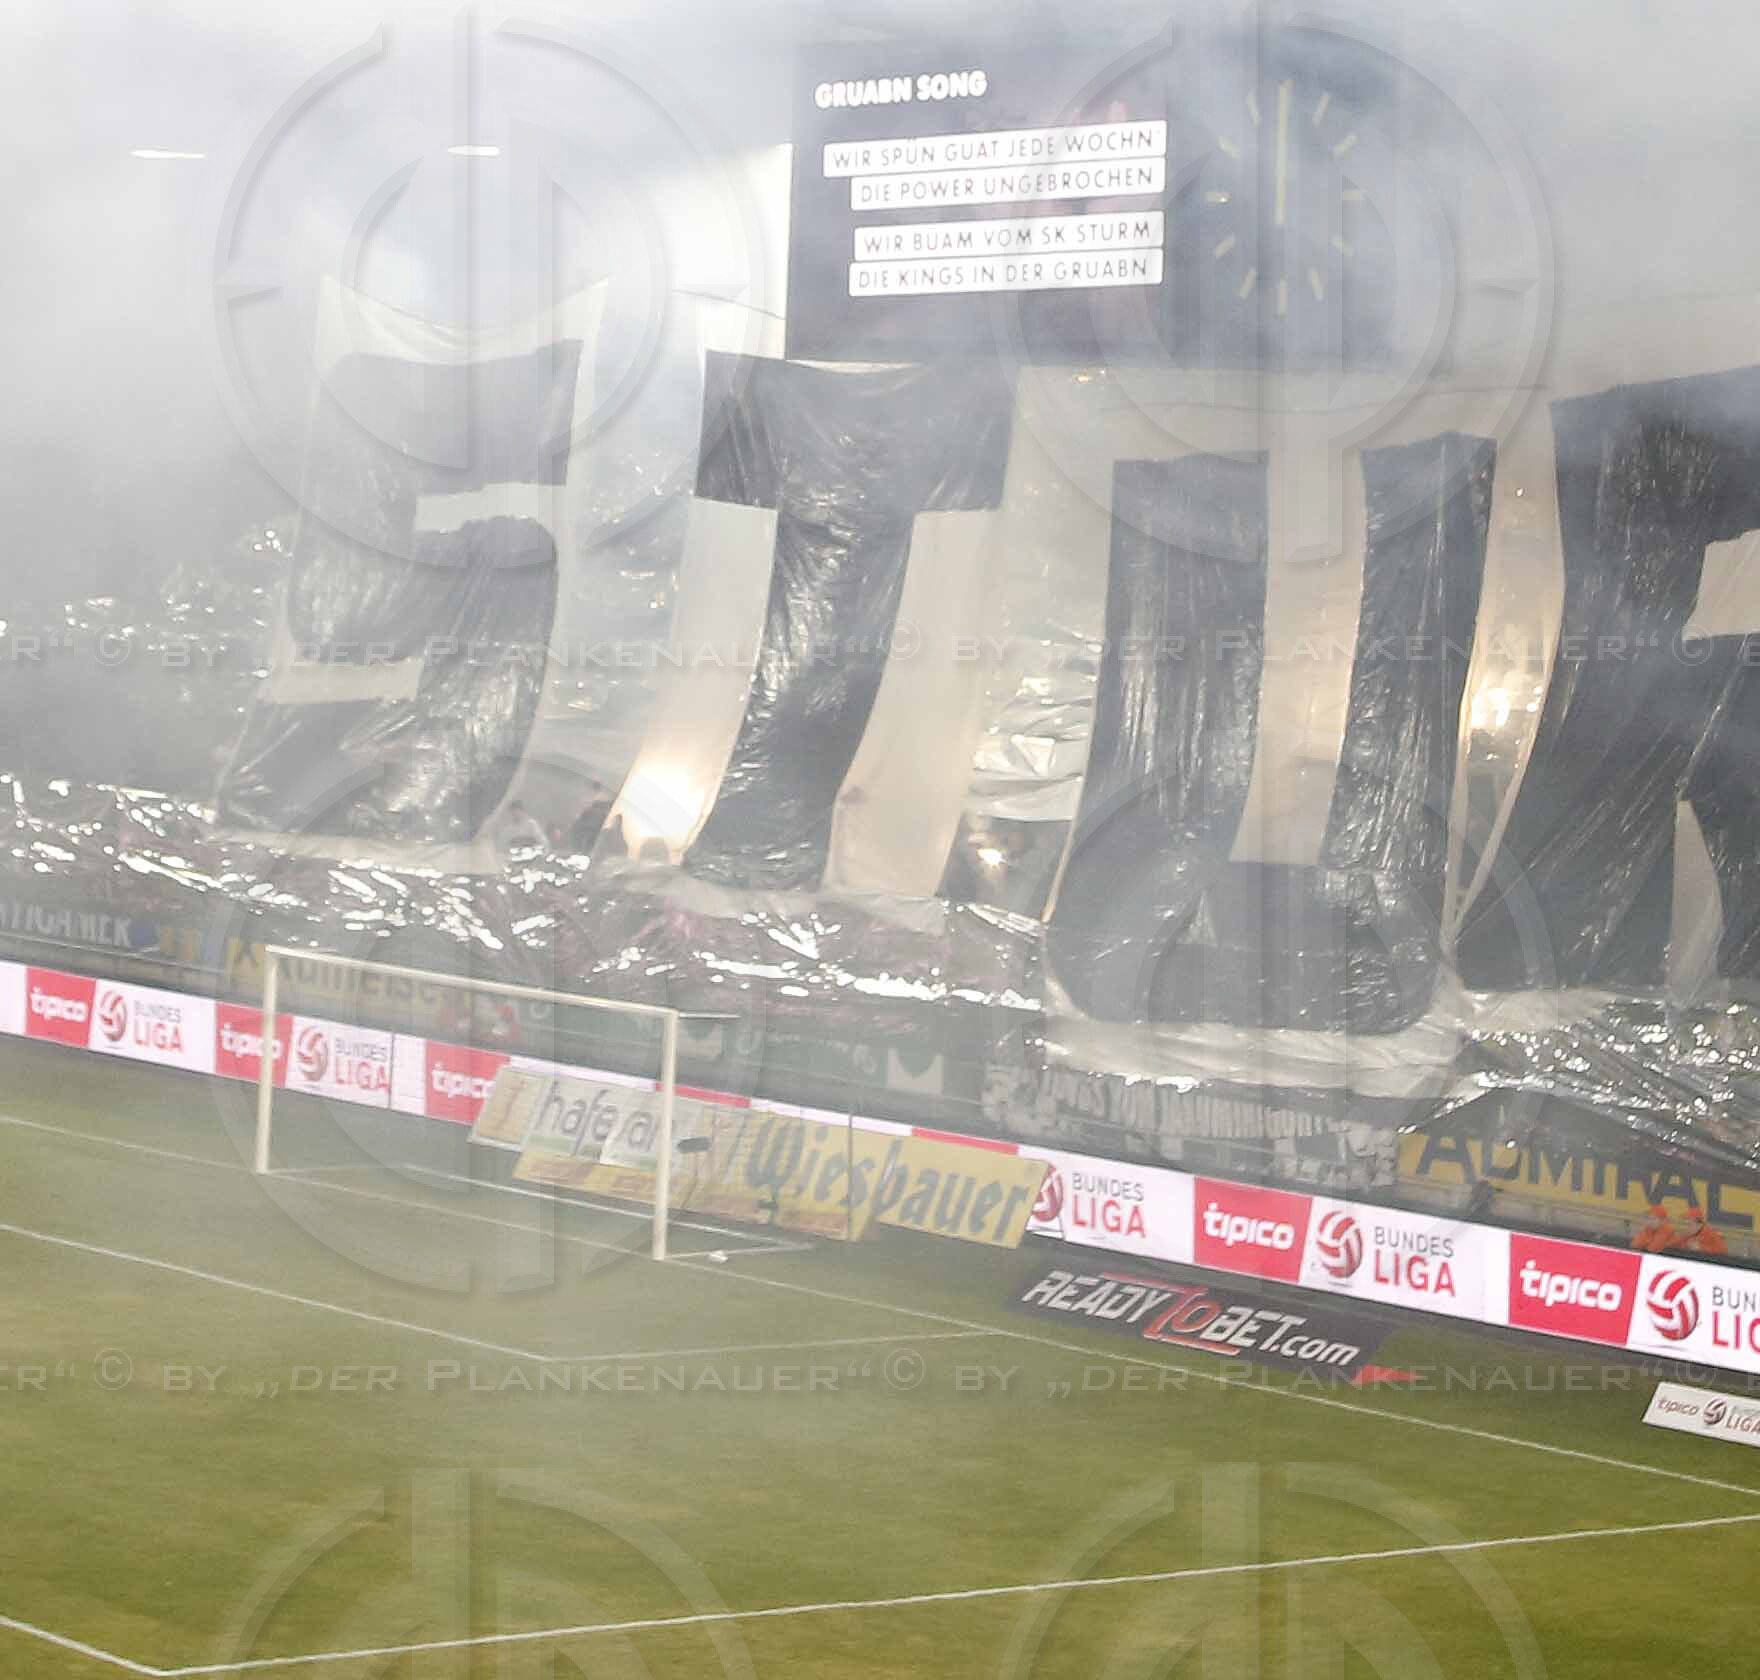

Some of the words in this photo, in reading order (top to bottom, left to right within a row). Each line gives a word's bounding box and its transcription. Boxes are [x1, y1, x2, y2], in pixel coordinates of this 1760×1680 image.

[815, 77, 912, 108] GRUABN
[917, 71, 987, 101] SONG
[834, 149, 871, 169] WIR
[944, 139, 998, 162] GUAT
[1008, 135, 1055, 158] JEDE
[861, 183, 891, 203] DIE
[900, 178, 975, 200] POWER
[983, 167, 1153, 196] UNGEBROCHEN
[863, 232, 903, 254] WIR
[913, 228, 973, 251] BUAM
[984, 225, 1033, 247] VOM
[1041, 222, 1066, 244] SK
[1076, 220, 1151, 243] STURM
[858, 268, 890, 289] DIE
[898, 265, 965, 287] KINGS
[973, 263, 995, 284] IN
[1005, 261, 1043, 283] DER
[134, 1022, 184, 1053] LIGA
[335, 1060, 390, 1092] LIGA
[1071, 1172, 1145, 1203] BUNDES
[1071, 1198, 1148, 1239] LIGA
[1203, 1202, 1296, 1250] tipico
[1372, 1225, 1456, 1260] BUNDES
[1372, 1249, 1458, 1299] LIGA
[1520, 1260, 1622, 1310] tipico
[1656, 1393, 1701, 1418] tipico
